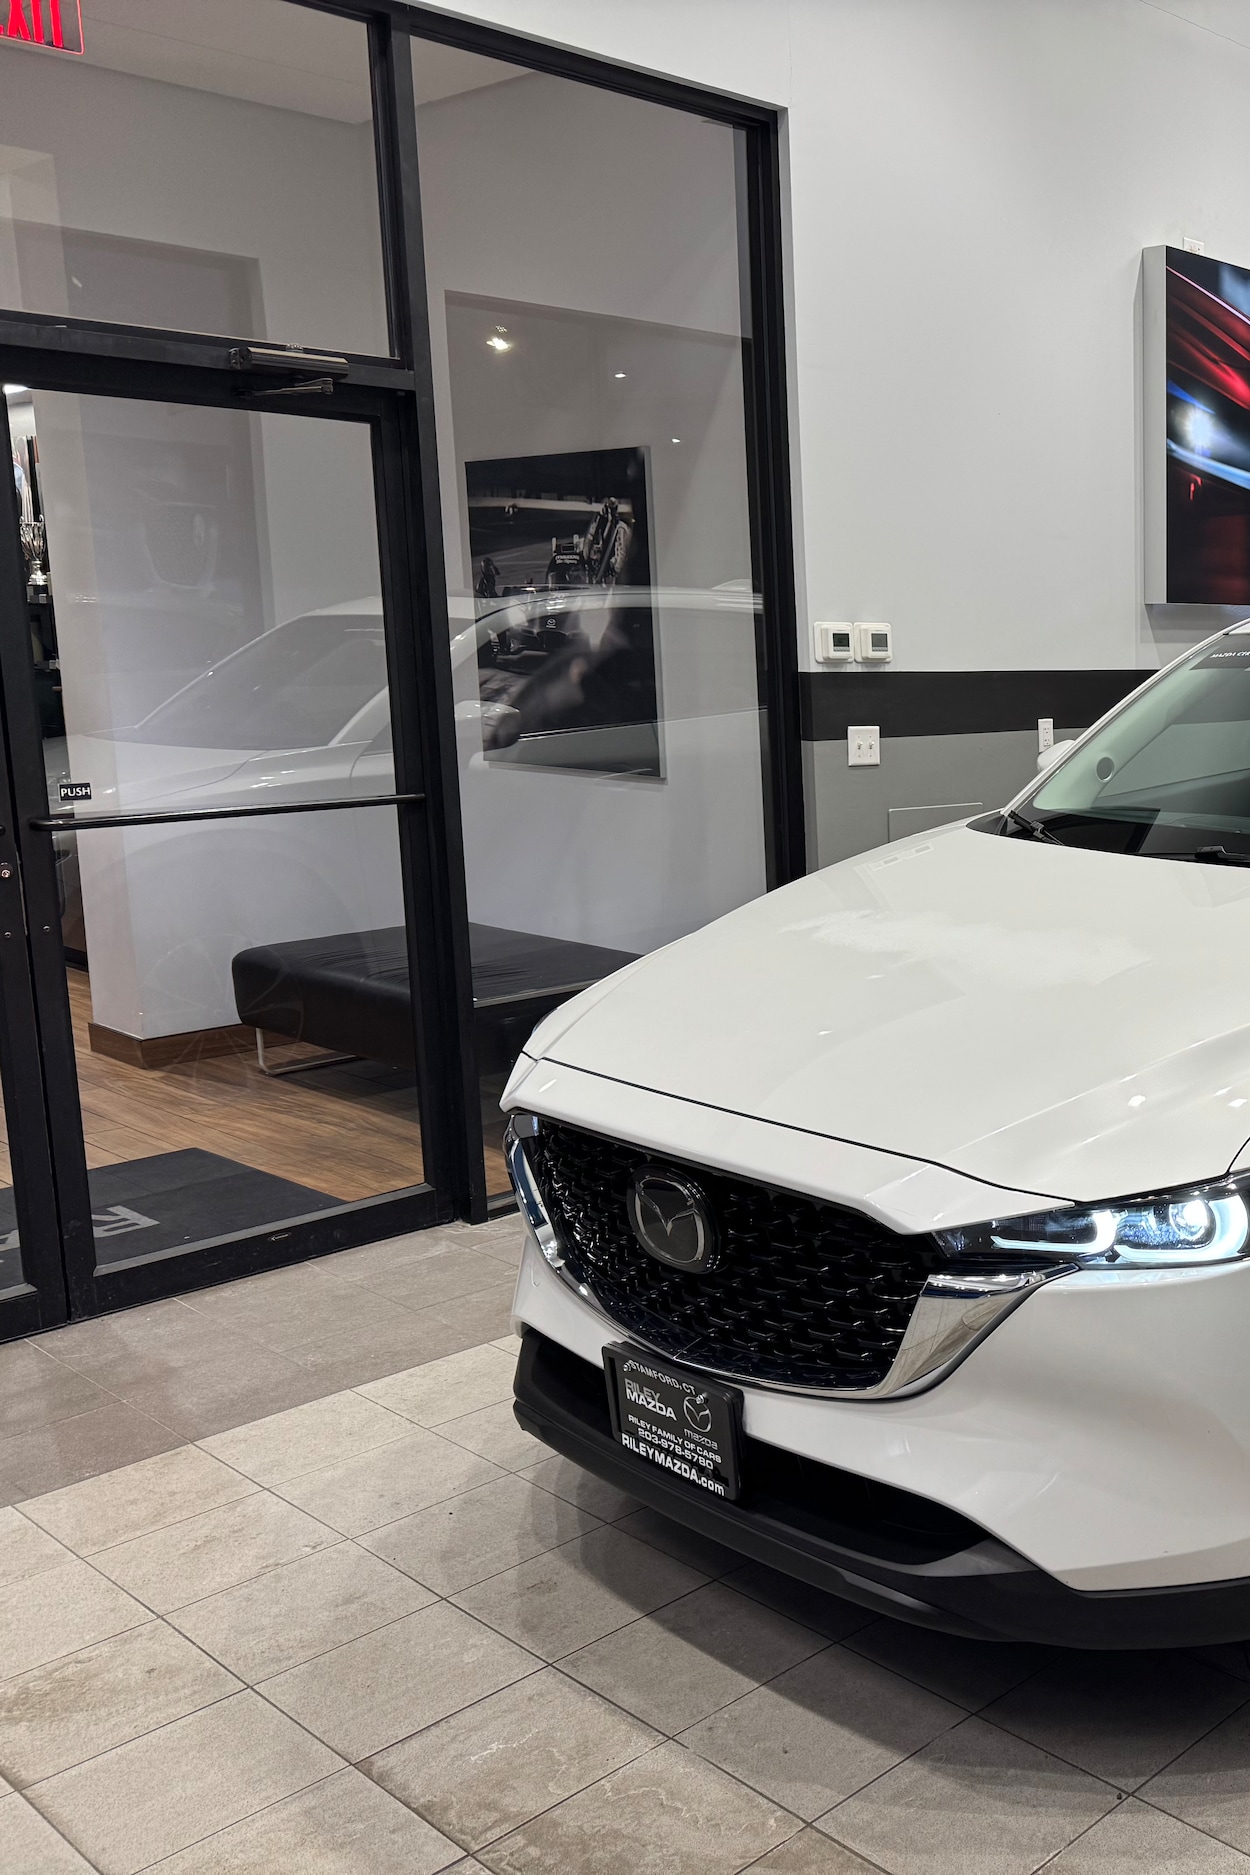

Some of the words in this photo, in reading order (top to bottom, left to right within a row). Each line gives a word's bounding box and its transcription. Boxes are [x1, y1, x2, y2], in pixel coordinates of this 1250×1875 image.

[1210, 651, 1237, 659] MAZDA
[60, 787, 91, 797] PUSH
[624, 1377, 660, 1402] RILEY
[625, 1388, 678, 1421] MAZDA
[628, 1413, 651, 1430] RILEY
[652, 1424, 683, 1444] FAMILY
[684, 1440, 696, 1450] OF
[697, 1446, 722, 1463] CARS
[621, 1432, 725, 1496] RILEYMAZDA.com
